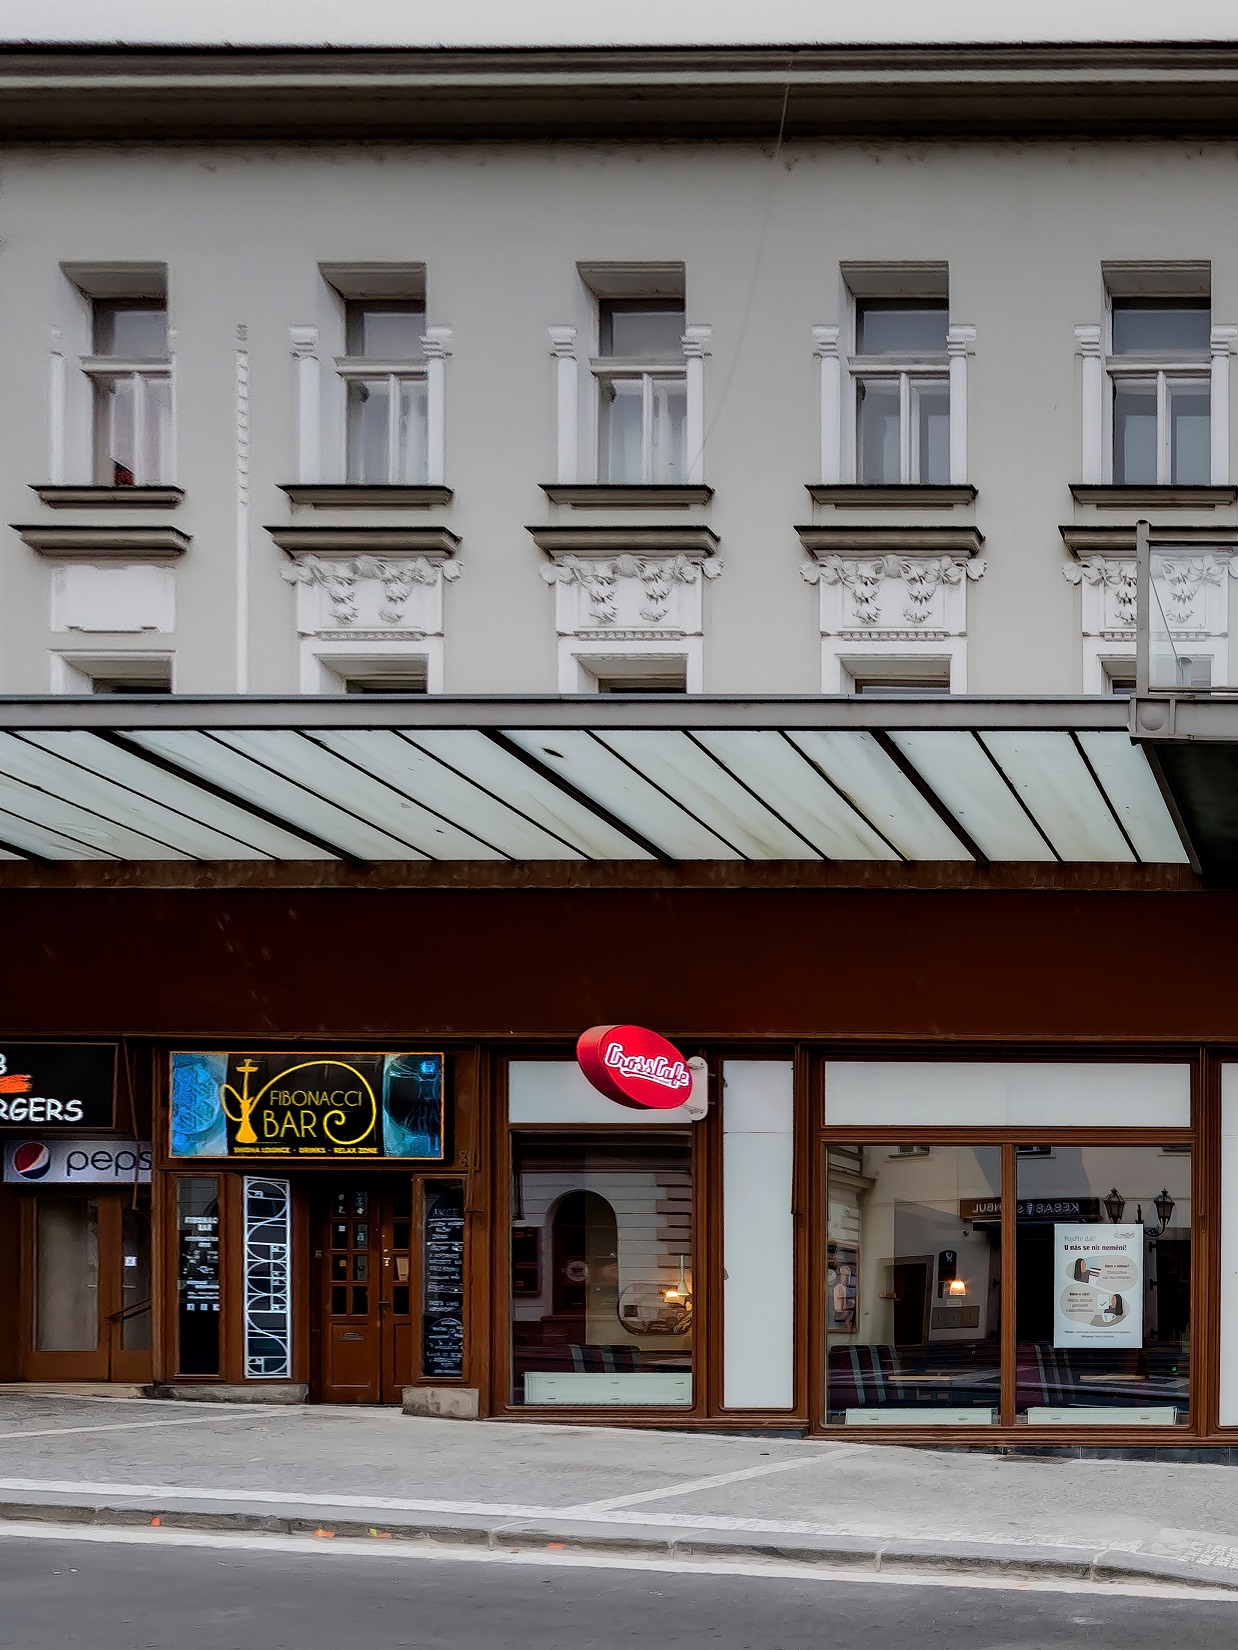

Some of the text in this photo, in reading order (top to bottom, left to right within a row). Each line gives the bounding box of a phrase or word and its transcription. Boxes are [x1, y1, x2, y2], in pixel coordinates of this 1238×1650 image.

[605, 1043, 689, 1088] CrossCafe
[269, 1090, 363, 1107] FIBONACCI
[263, 1110, 317, 1138] BAR
